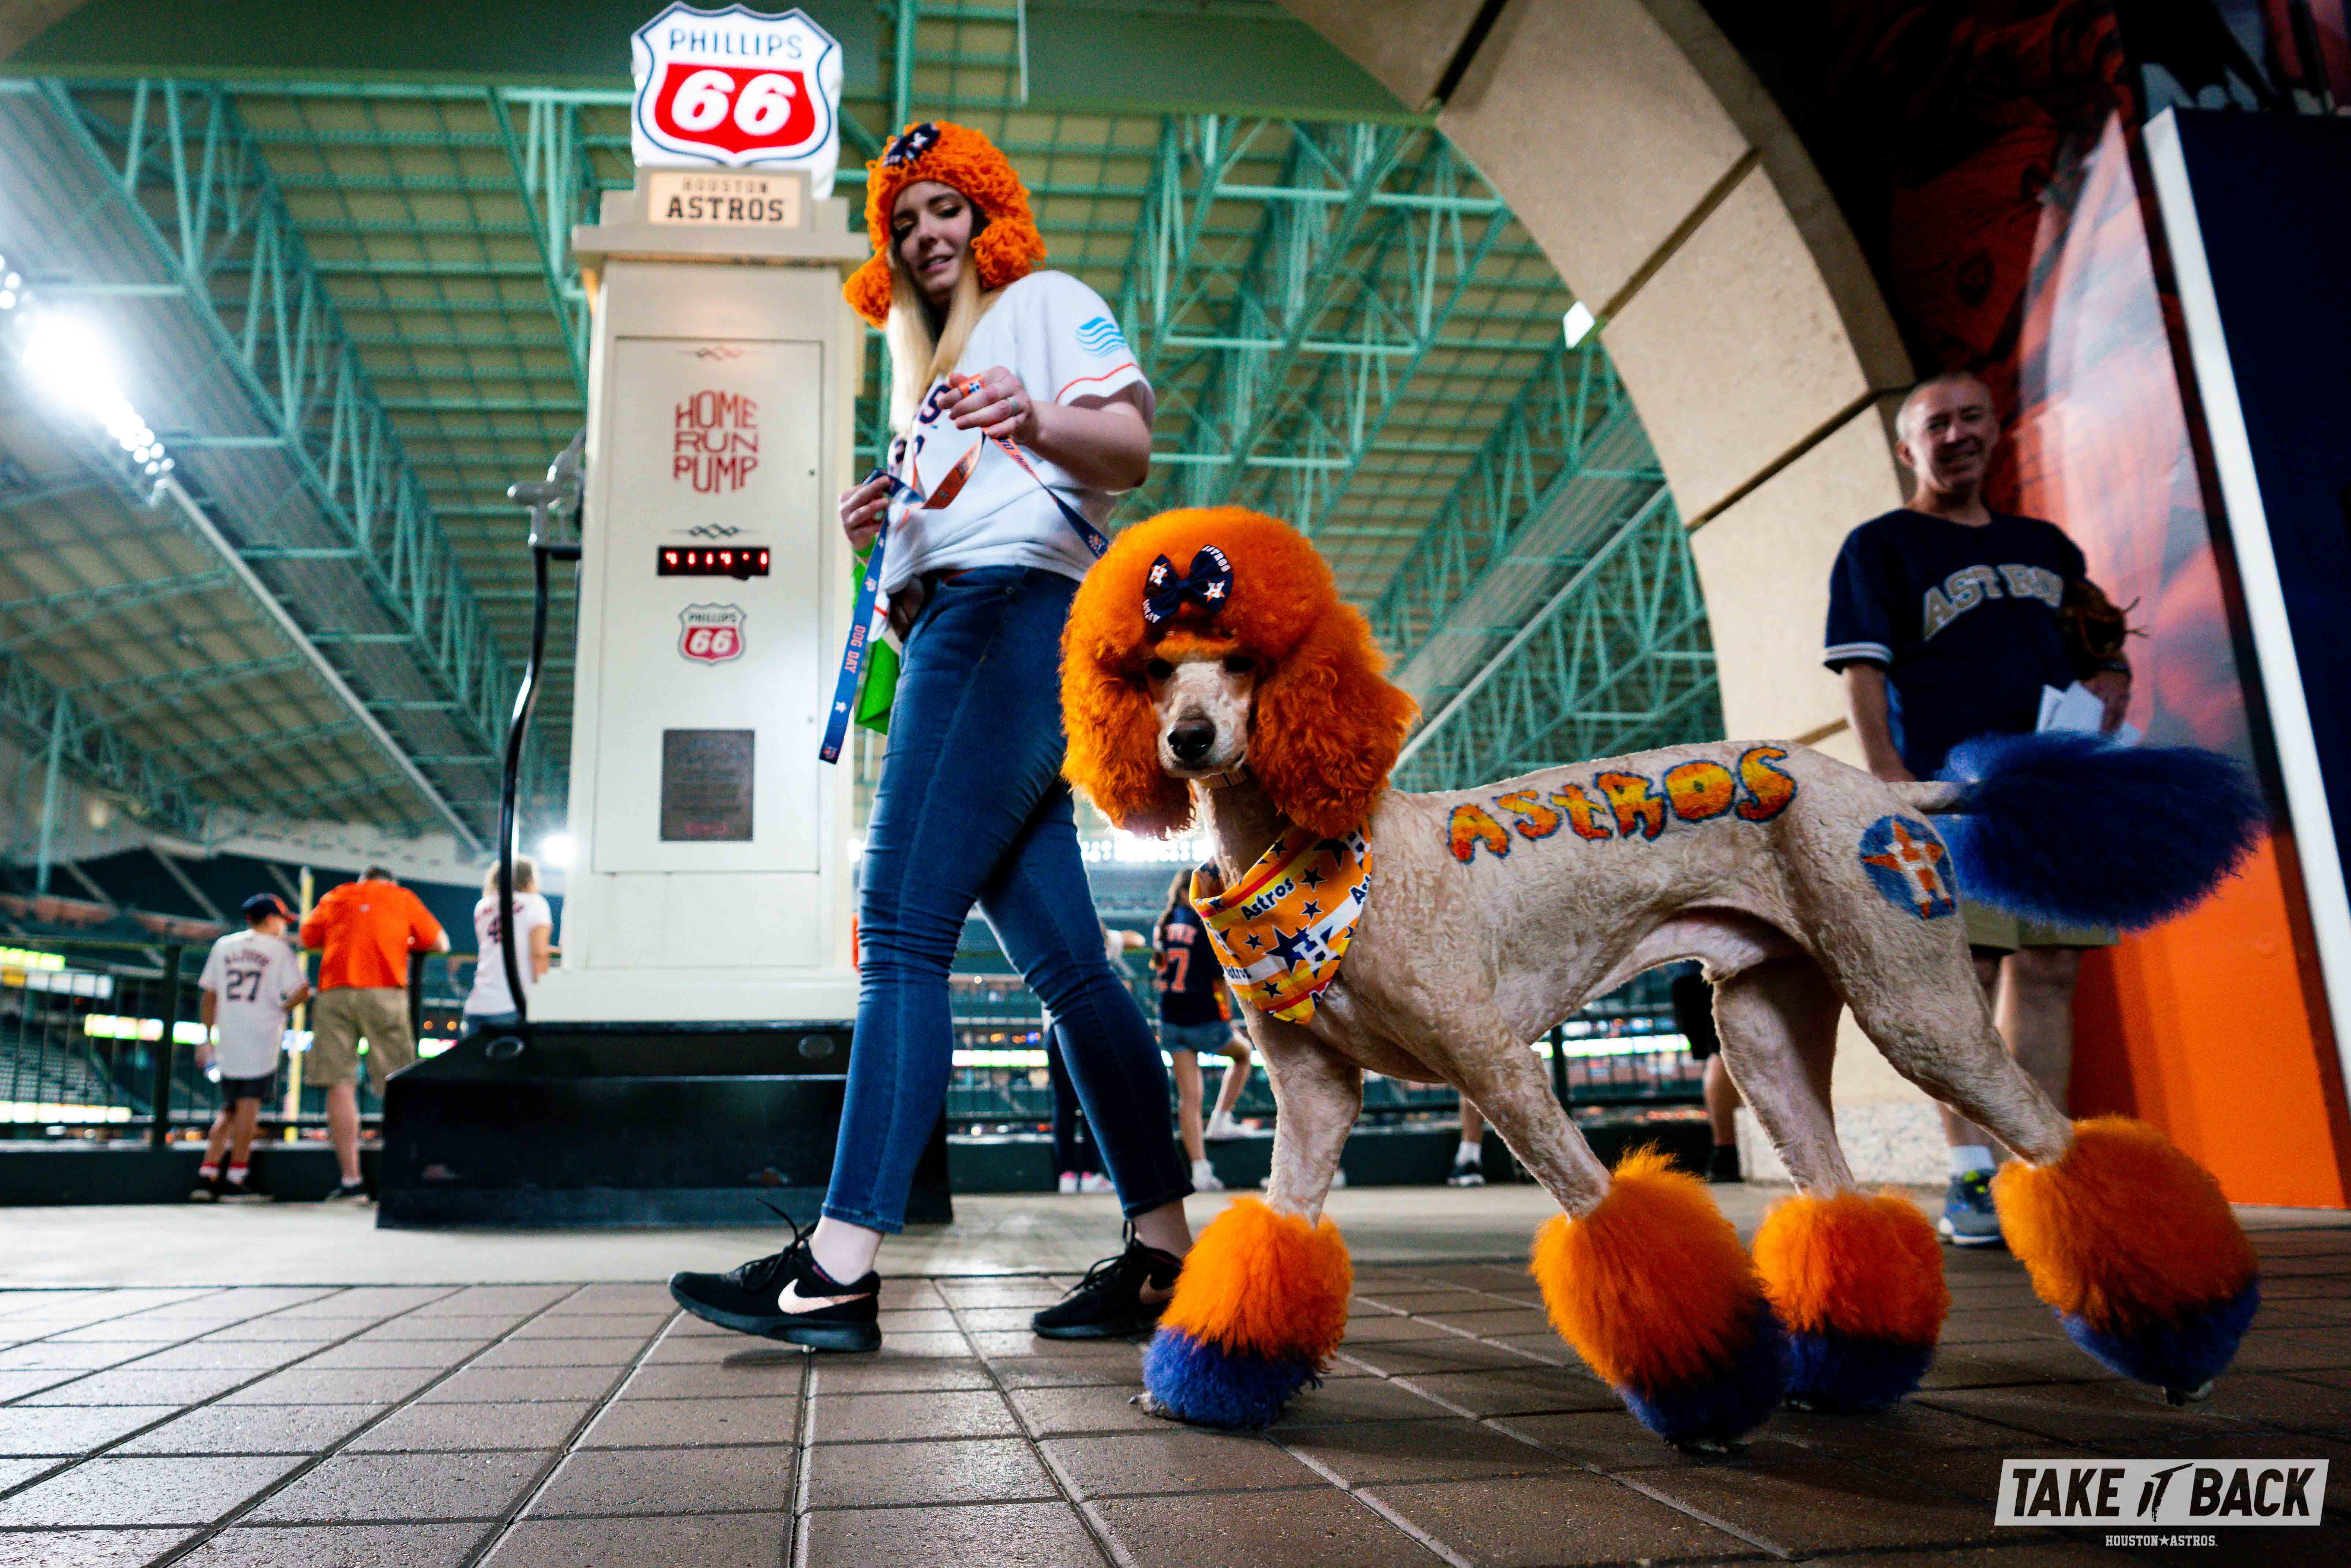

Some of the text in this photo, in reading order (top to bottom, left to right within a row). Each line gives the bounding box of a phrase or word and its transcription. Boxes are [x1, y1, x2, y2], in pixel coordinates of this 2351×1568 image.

[668, 29, 803, 59] PHILLIPS
[671, 69, 797, 137] 66
[683, 178, 769, 193] HOUSTON
[667, 197, 785, 222] ASTROS
[675, 389, 758, 429] HOME
[673, 431, 759, 453] RUN
[673, 456, 759, 494] PUMP
[690, 629, 734, 655] 66
[845, 624, 866, 673] DOG DAY
[1240, 877, 1295, 920] Astros
[226, 969, 261, 1001] 27
